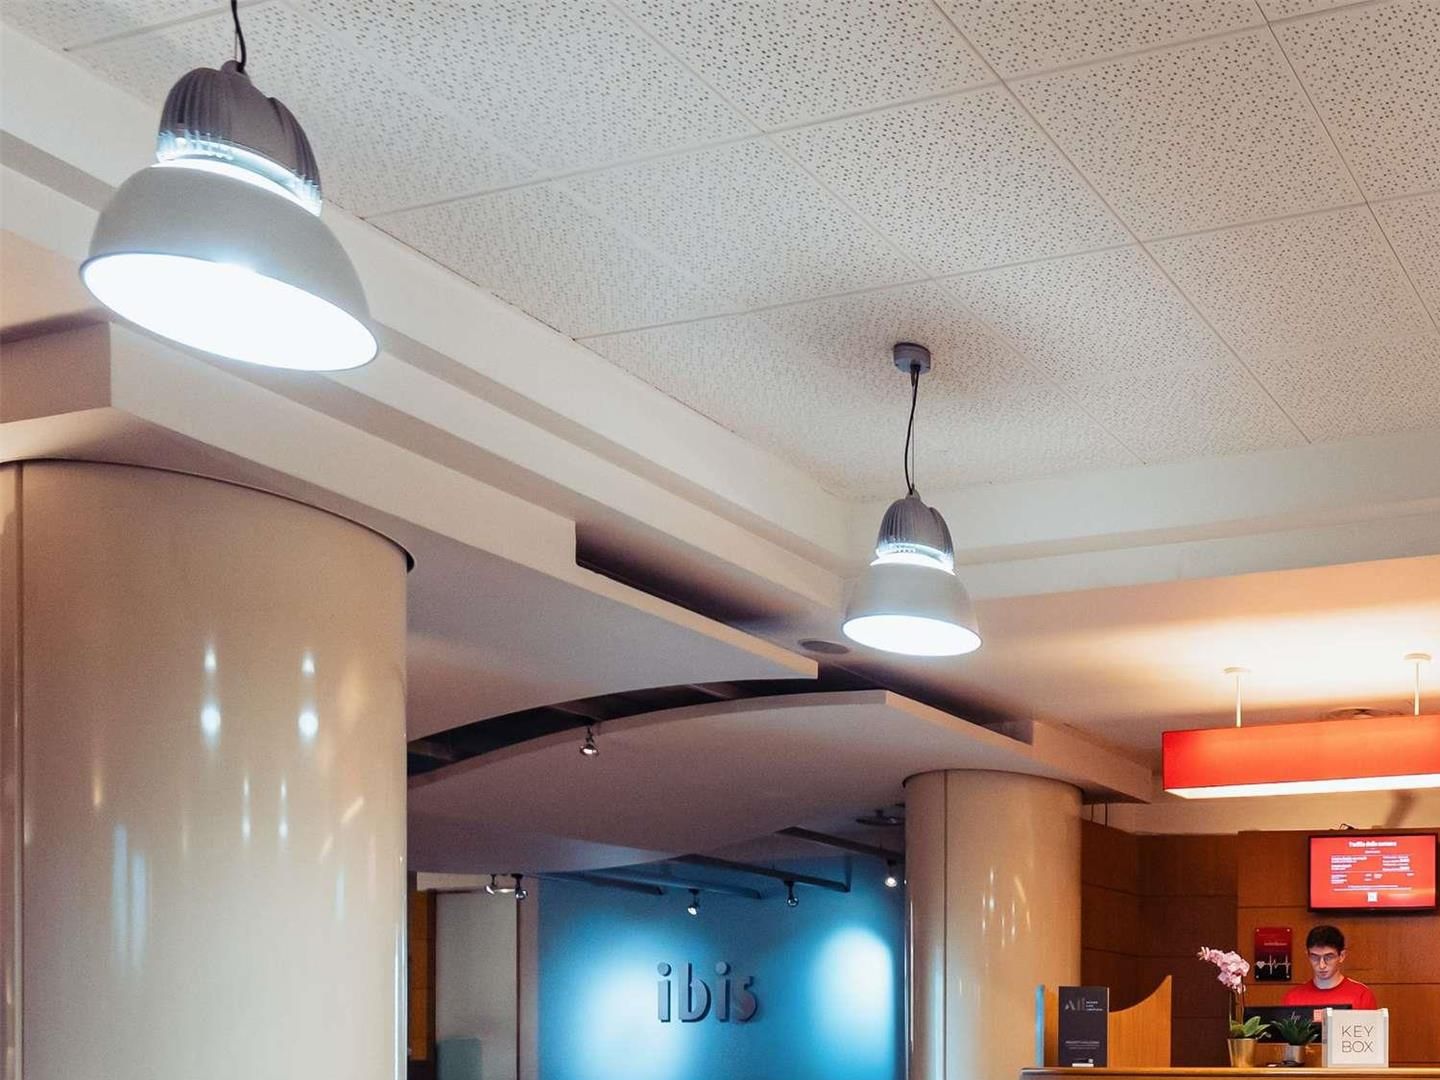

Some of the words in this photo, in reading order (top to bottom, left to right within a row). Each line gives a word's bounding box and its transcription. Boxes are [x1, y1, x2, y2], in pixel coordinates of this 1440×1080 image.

[657, 961, 758, 1023] ibis
[1341, 1025, 1374, 1038] KEY
[1341, 1040, 1374, 1053] BOX
